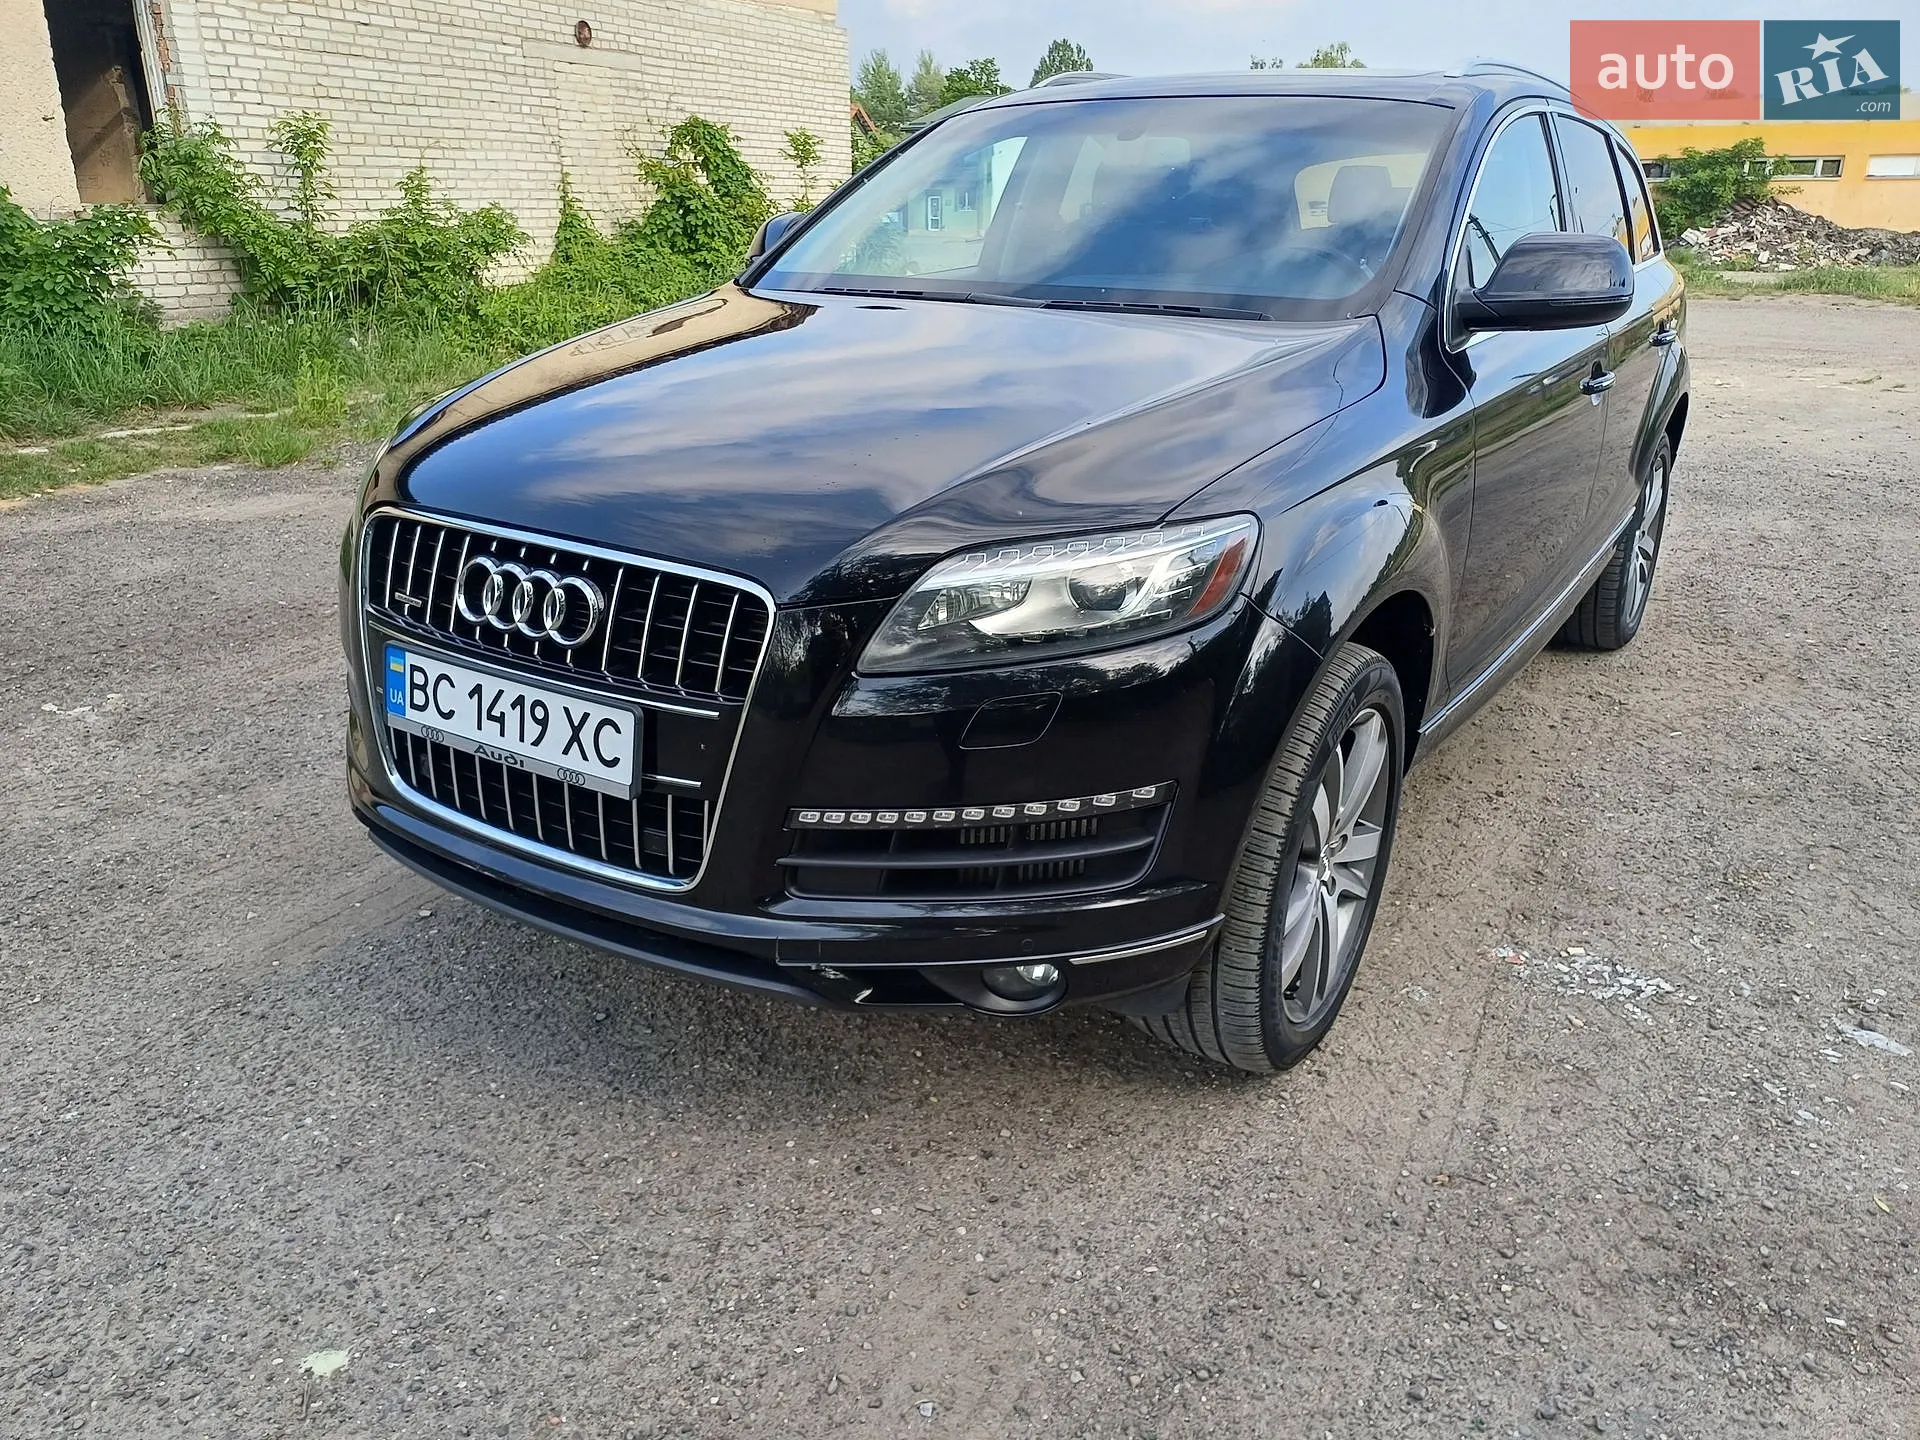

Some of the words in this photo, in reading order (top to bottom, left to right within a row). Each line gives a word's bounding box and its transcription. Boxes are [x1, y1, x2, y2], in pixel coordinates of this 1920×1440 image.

[390, 687, 404, 706] UA
[409, 664, 456, 720] BC
[467, 683, 550, 748] 1419
[561, 706, 622, 768] XC
[474, 744, 525, 768] Audi
